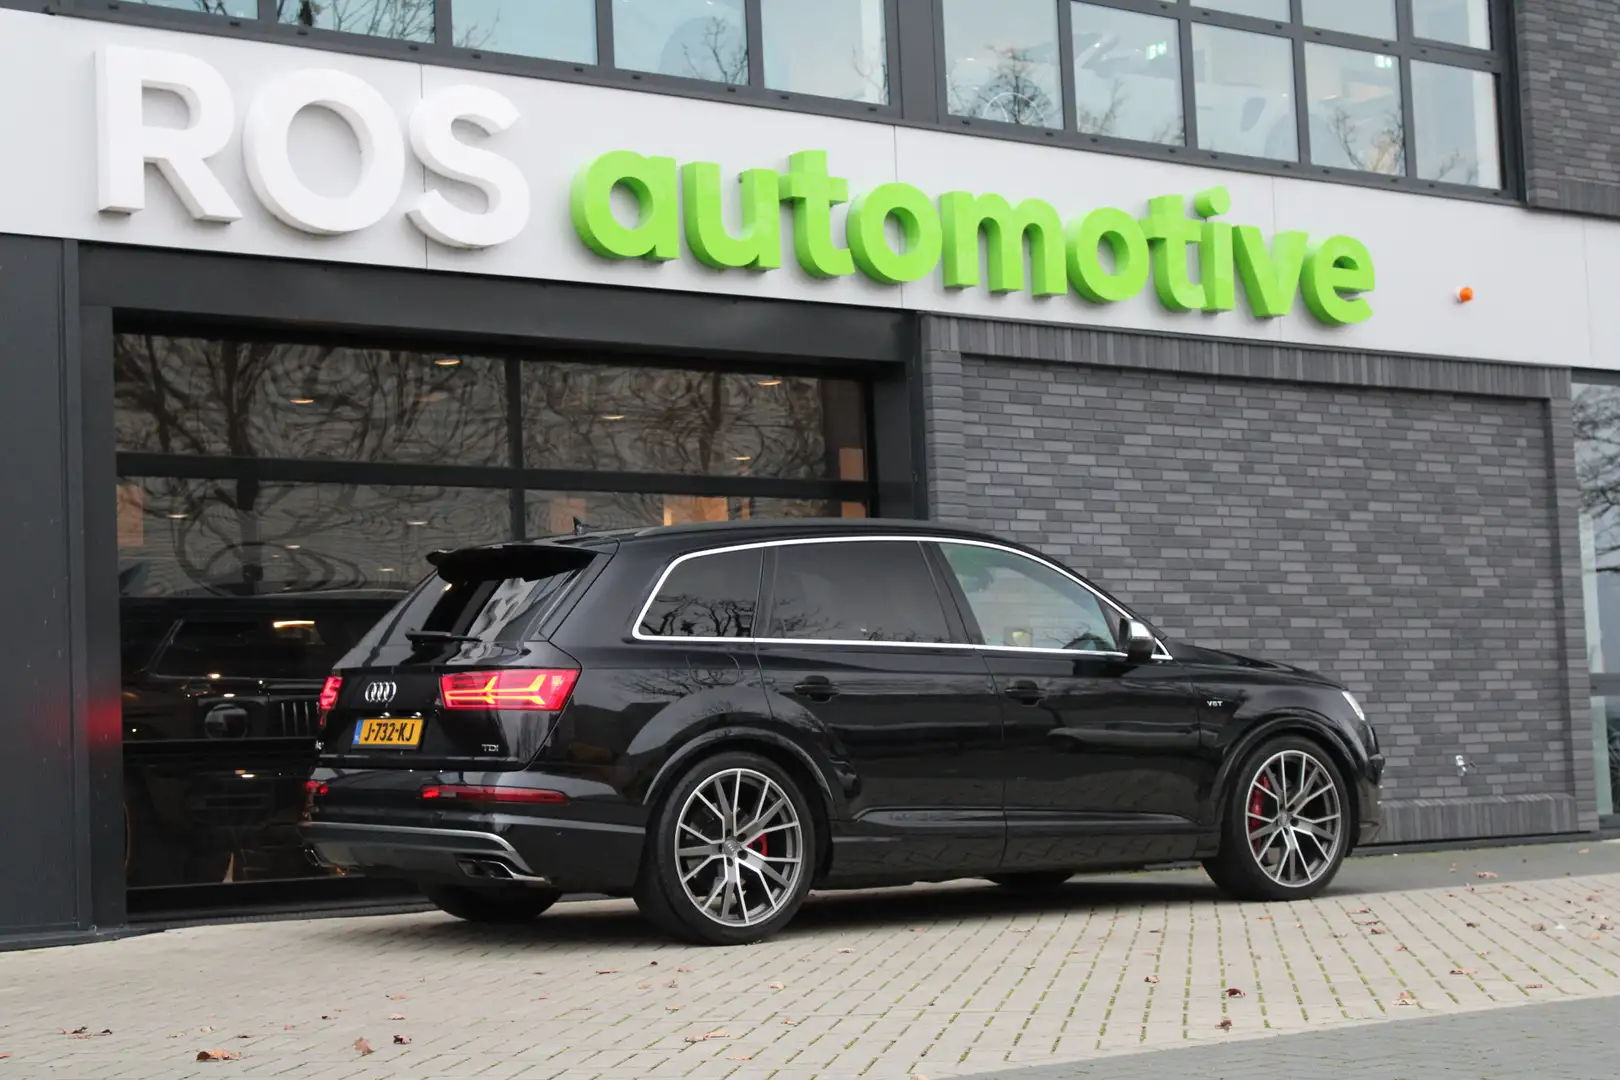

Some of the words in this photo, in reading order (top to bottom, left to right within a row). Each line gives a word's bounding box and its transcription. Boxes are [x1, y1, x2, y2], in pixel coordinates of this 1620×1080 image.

[94, 44, 531, 249] ROS
[570, 150, 1374, 324] automotive
[363, 722, 415, 742] J-732-KJ
[481, 743, 499, 752] TDI
